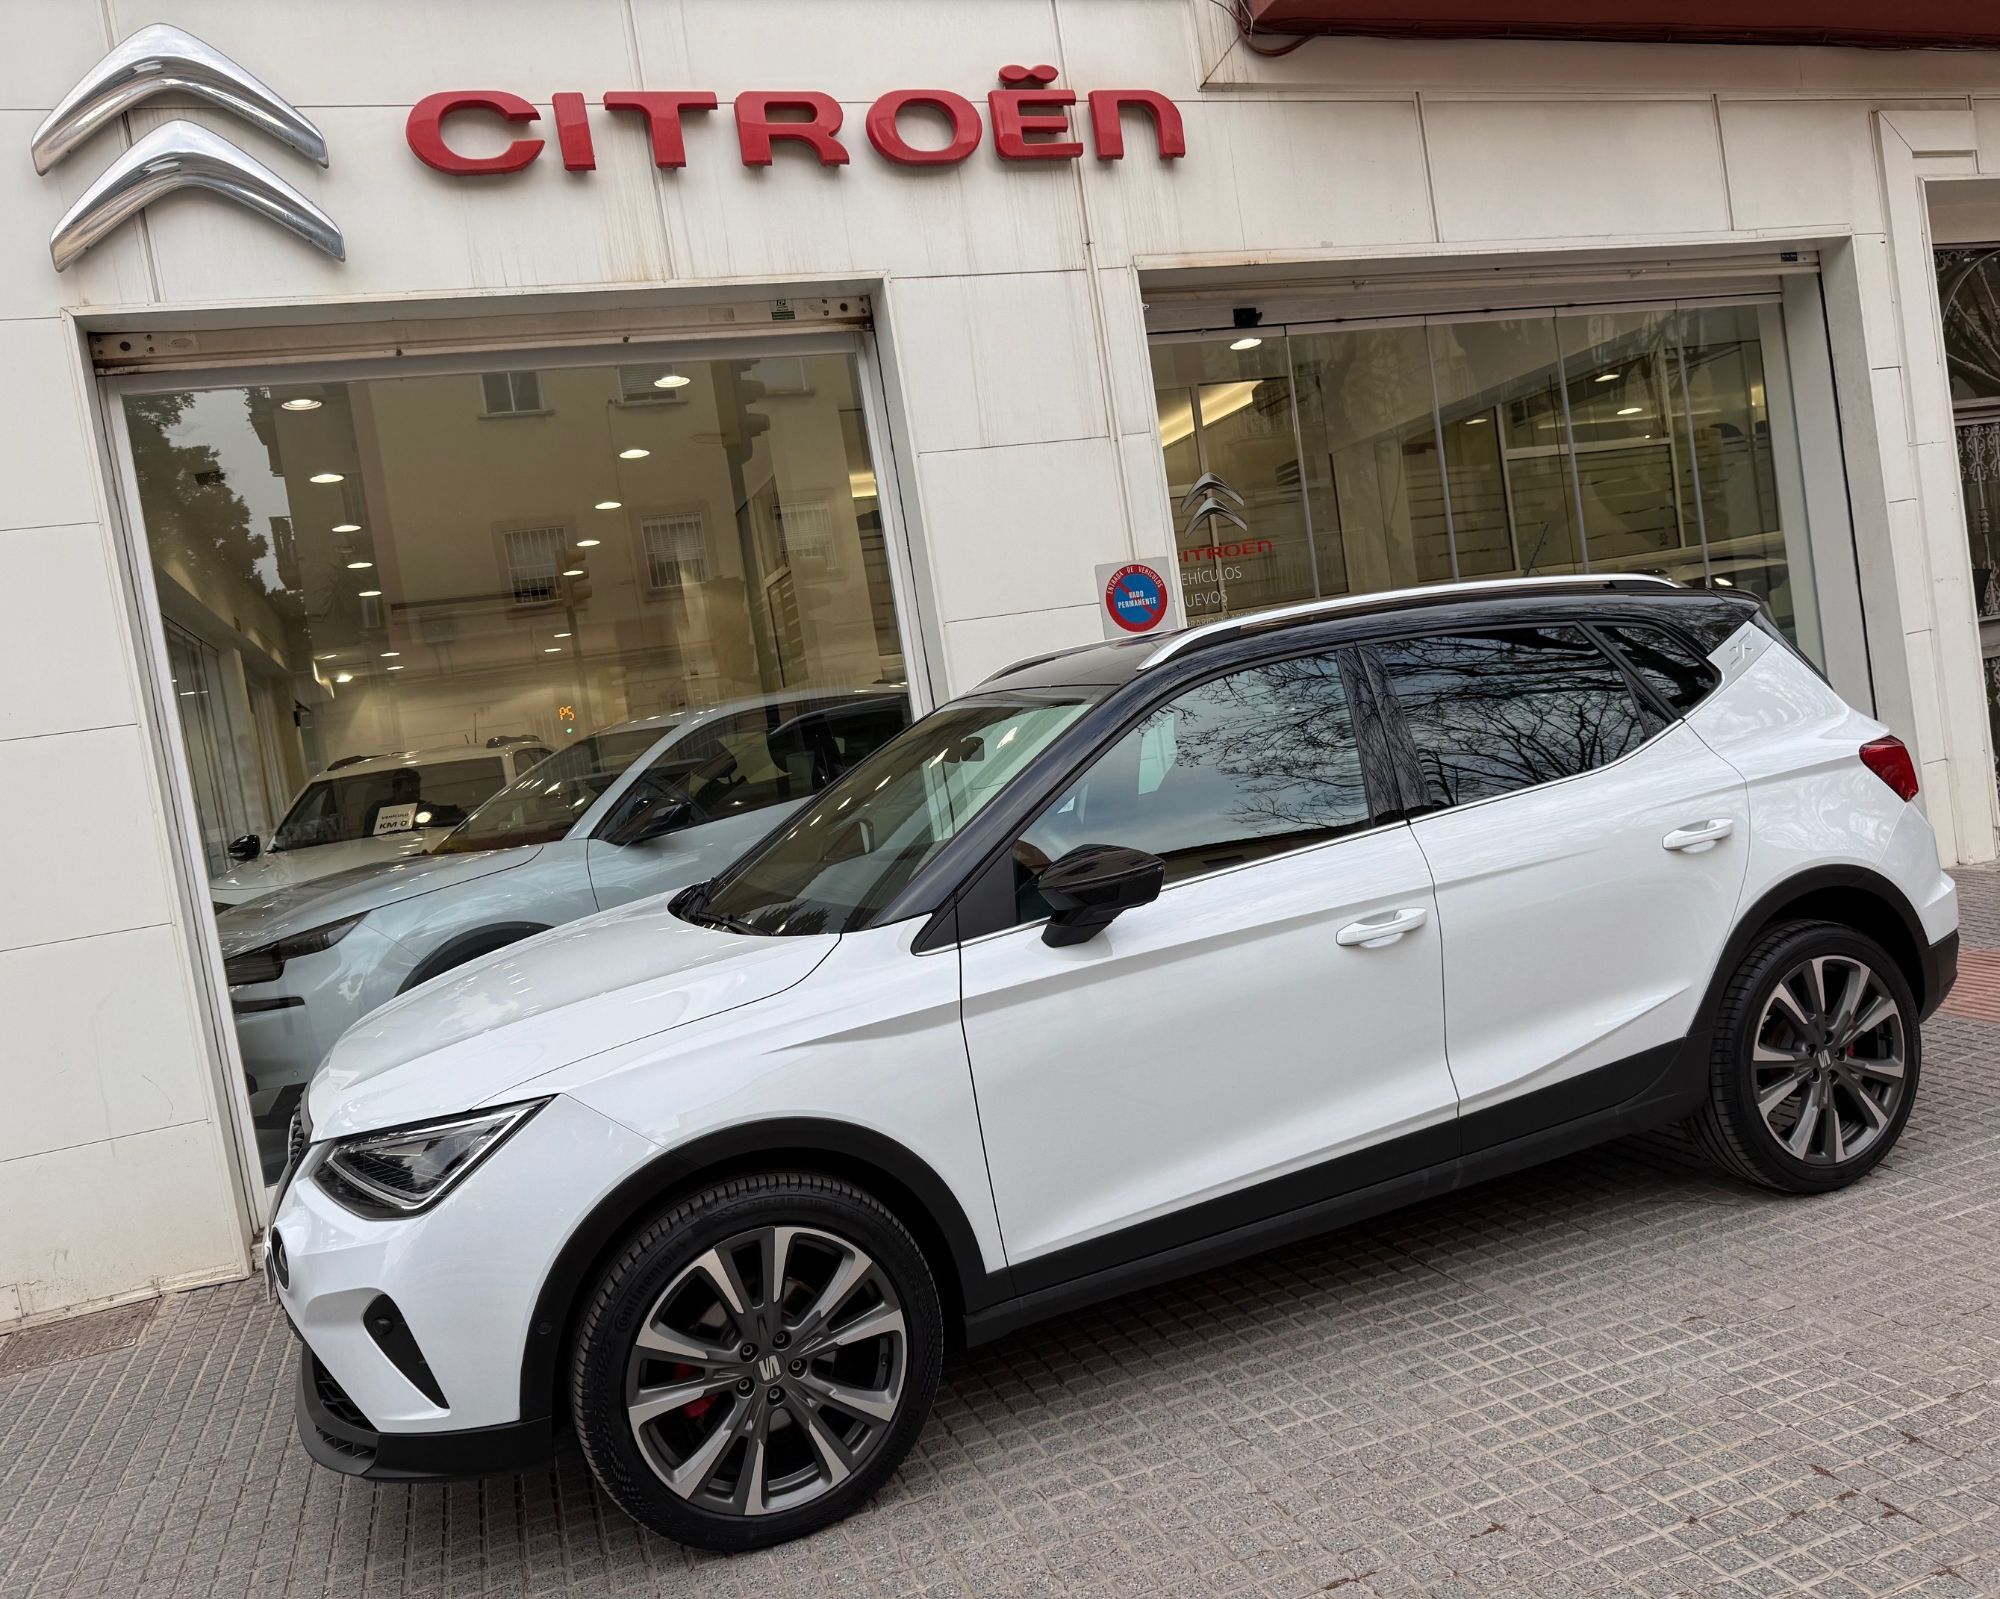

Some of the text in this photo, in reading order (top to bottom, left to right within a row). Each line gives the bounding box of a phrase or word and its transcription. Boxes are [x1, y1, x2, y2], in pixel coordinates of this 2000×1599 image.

[1178, 537, 1274, 562] ITROËN
[1126, 565, 1134, 574] DE
[1180, 565, 1242, 587] EHÍCULOS
[1128, 590, 1145, 599] VADO
[1184, 589, 1228, 609] UEVOS
[1117, 596, 1157, 609] PERMANENTE
[379, 820, 398, 830] KM
